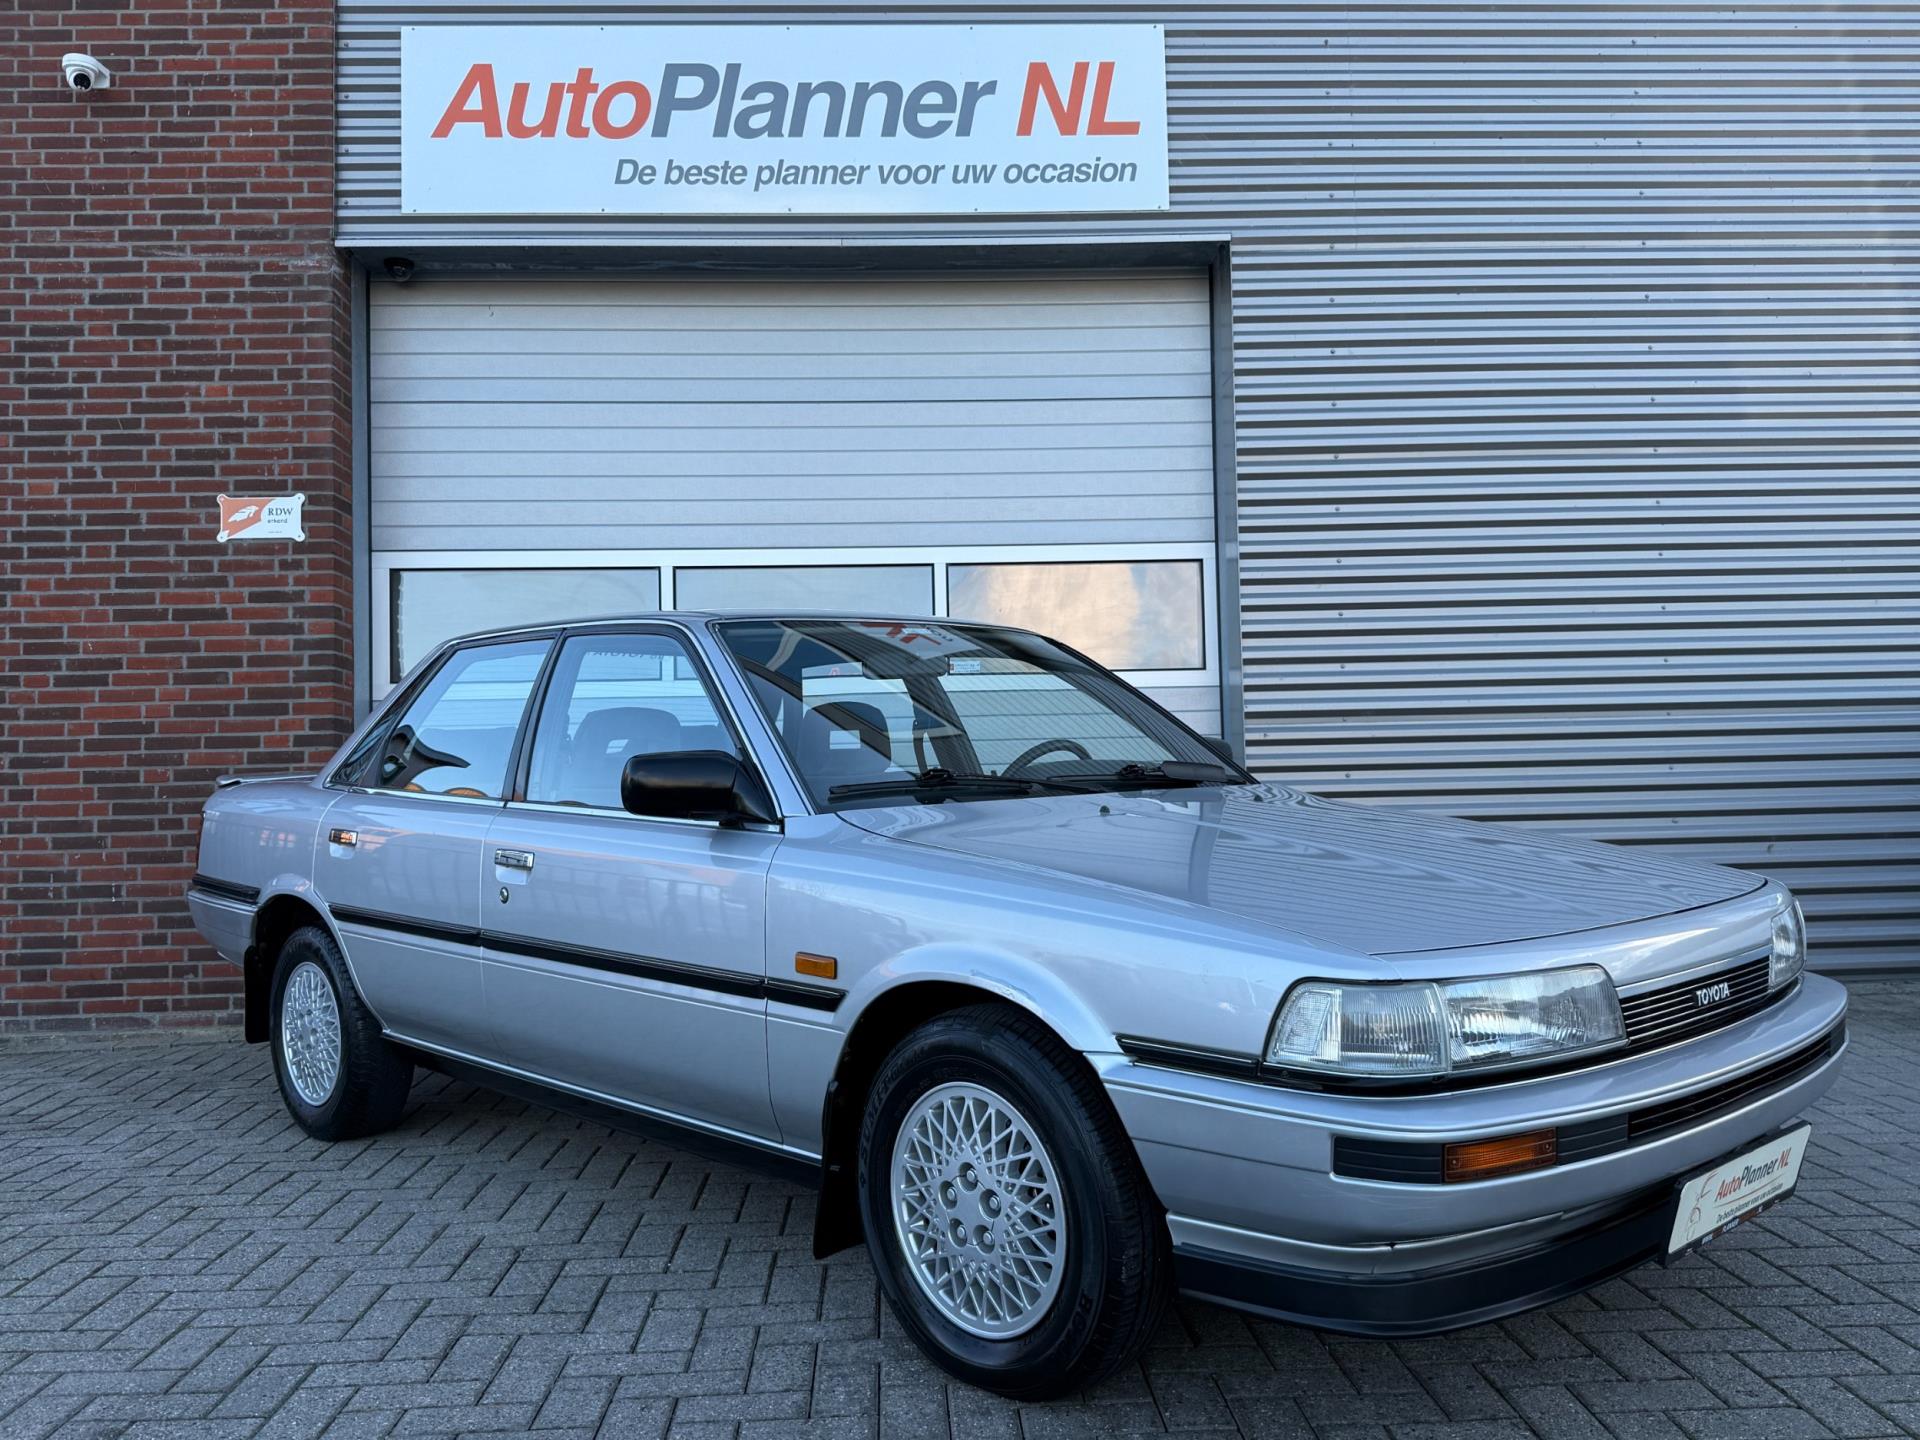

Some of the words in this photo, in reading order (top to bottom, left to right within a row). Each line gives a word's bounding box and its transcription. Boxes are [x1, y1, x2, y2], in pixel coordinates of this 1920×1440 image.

[430, 62, 998, 140] AutoPlanner
[1016, 61, 1140, 137] NL
[614, 158, 657, 186] De
[663, 158, 748, 186] beste
[753, 158, 871, 193] planner
[877, 164, 946, 185] voor
[951, 164, 998, 185] uw
[1003, 156, 1138, 184] occasion
[267, 507, 294, 516] RDW
[1696, 982, 1730, 1006] TOYOTA
[1714, 1158, 1779, 1202] AutoPlanner
[1777, 1147, 1792, 1170] NL
